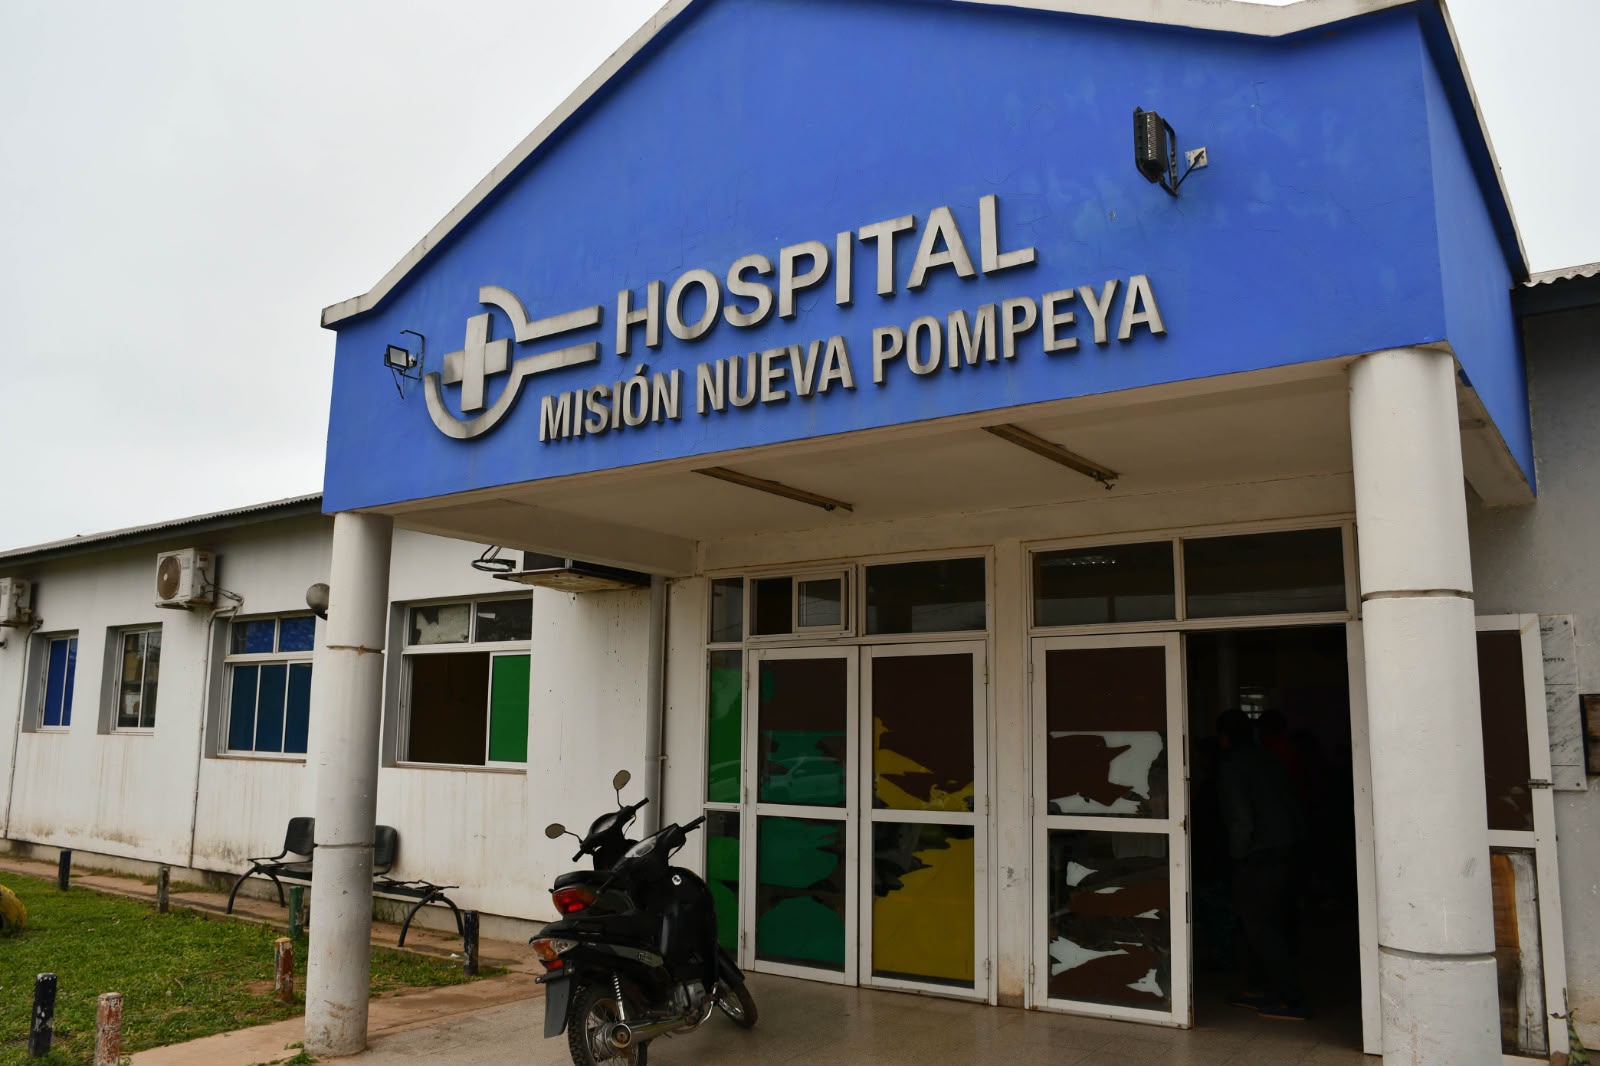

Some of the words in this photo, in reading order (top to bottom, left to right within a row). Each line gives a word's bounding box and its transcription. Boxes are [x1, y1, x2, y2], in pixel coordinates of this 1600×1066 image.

[616, 193, 1039, 356] HOSPITAL
[538, 363, 683, 443] MISIÓN
[697, 335, 857, 415] NUEVA
[872, 273, 1167, 385] POMPEYA
